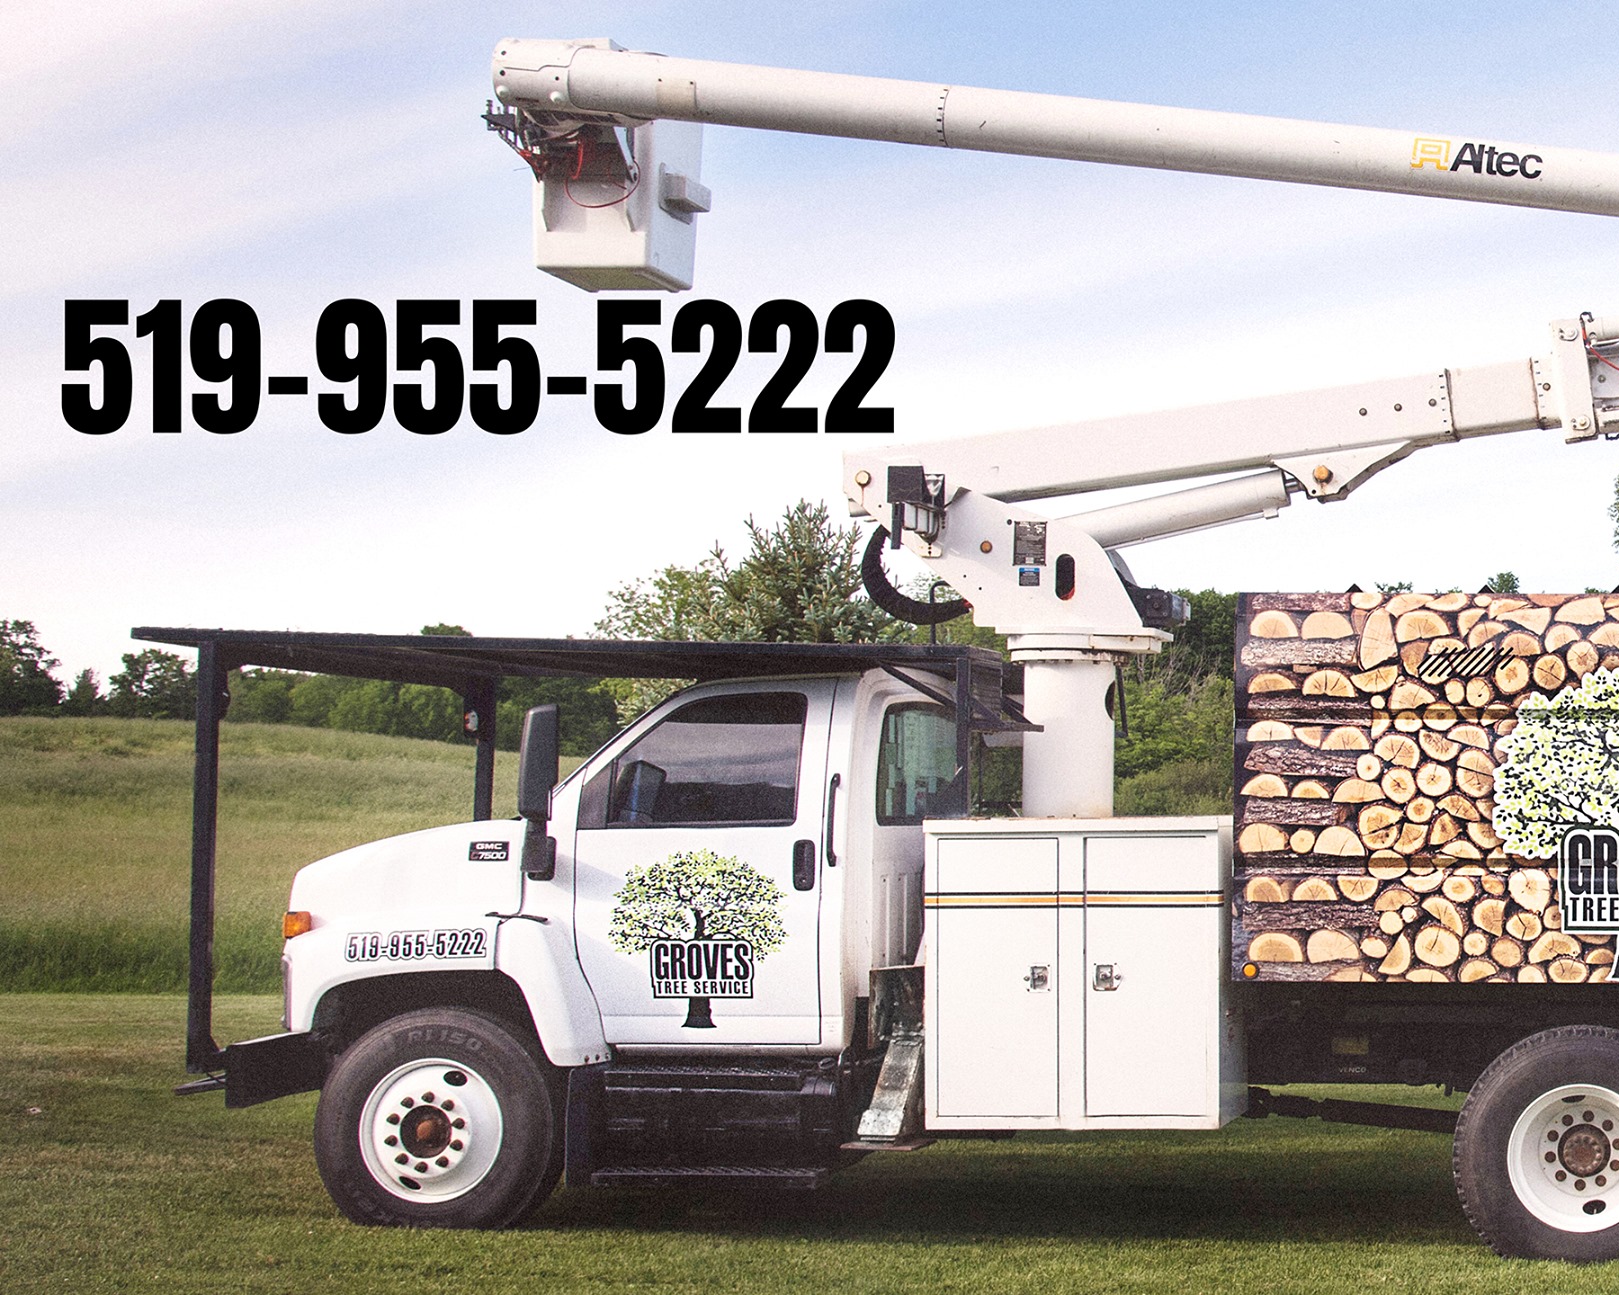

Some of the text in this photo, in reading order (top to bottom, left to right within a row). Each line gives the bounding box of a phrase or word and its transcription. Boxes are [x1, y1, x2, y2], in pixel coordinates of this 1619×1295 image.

[1450, 142, 1543, 179] Altec
[470, 851, 507, 860] C7500
[1569, 897, 1619, 922] TREE
[347, 932, 485, 959] 519-955-5222
[655, 943, 750, 980] GROVES
[656, 981, 748, 994] TREE SERVICE
